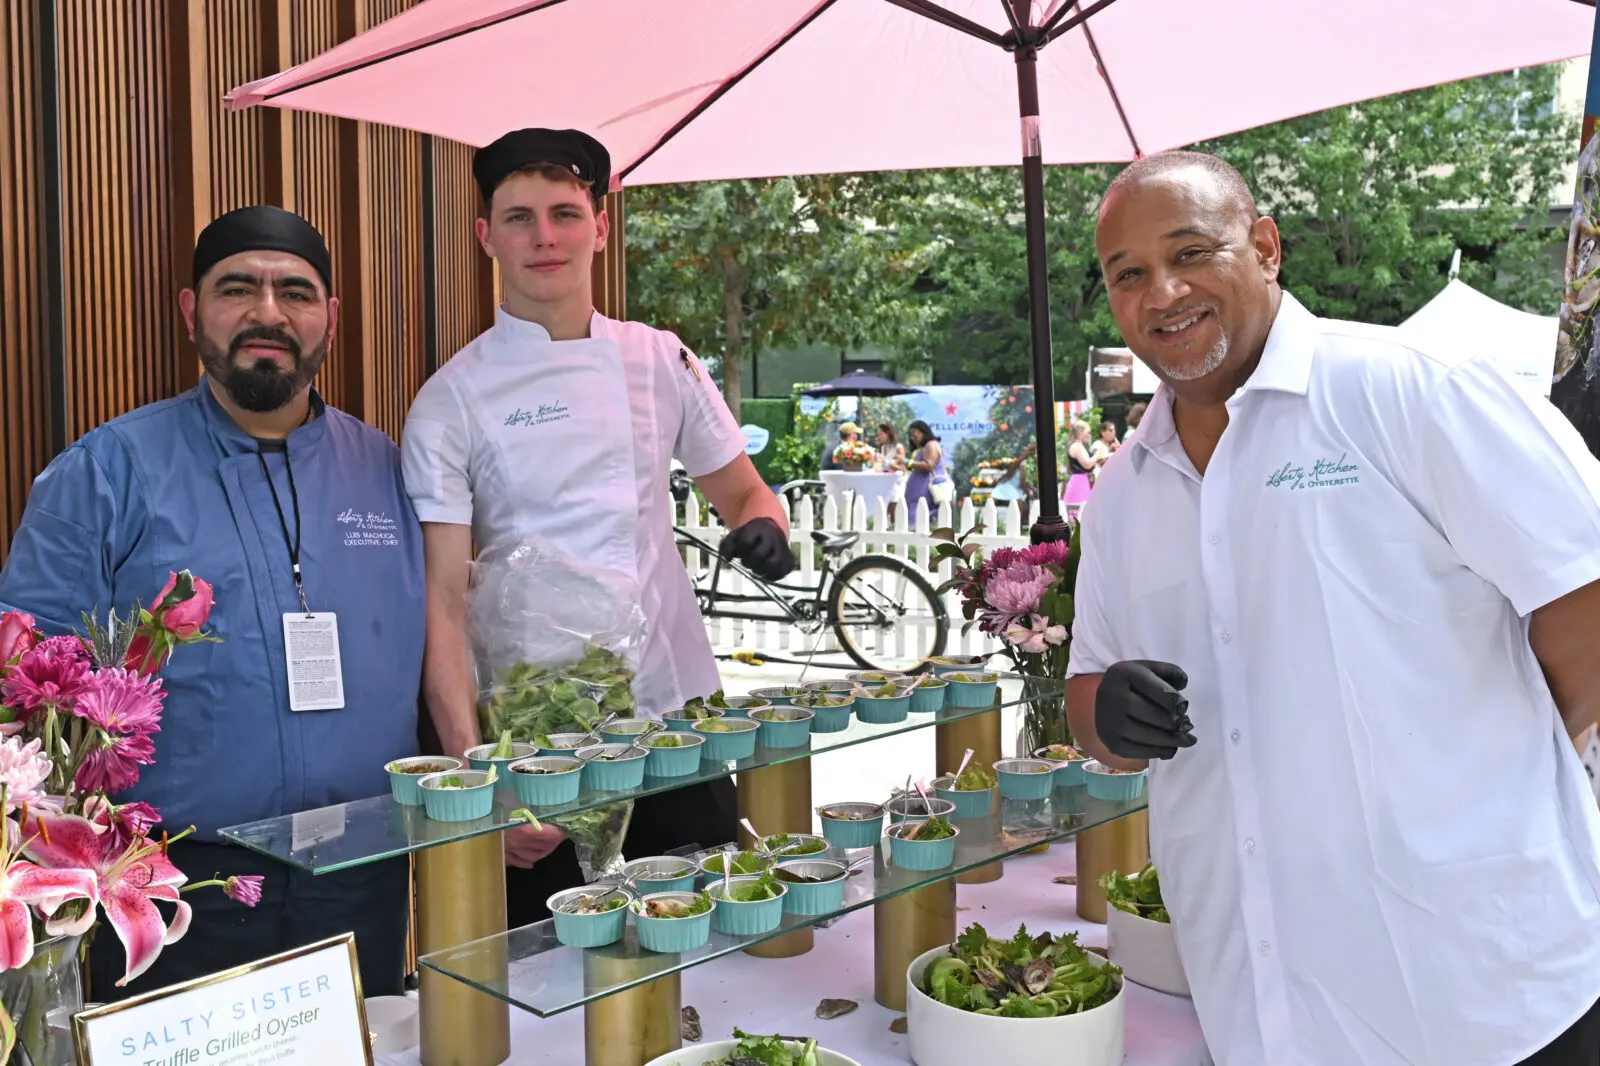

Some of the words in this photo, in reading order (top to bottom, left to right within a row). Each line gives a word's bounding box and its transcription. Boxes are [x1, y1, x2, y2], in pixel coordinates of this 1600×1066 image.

[121, 1011, 214, 1057] SALTY
[232, 974, 332, 1020] SISTER
[206, 1023, 261, 1056] Grilled
[266, 1006, 321, 1036] Oyster
